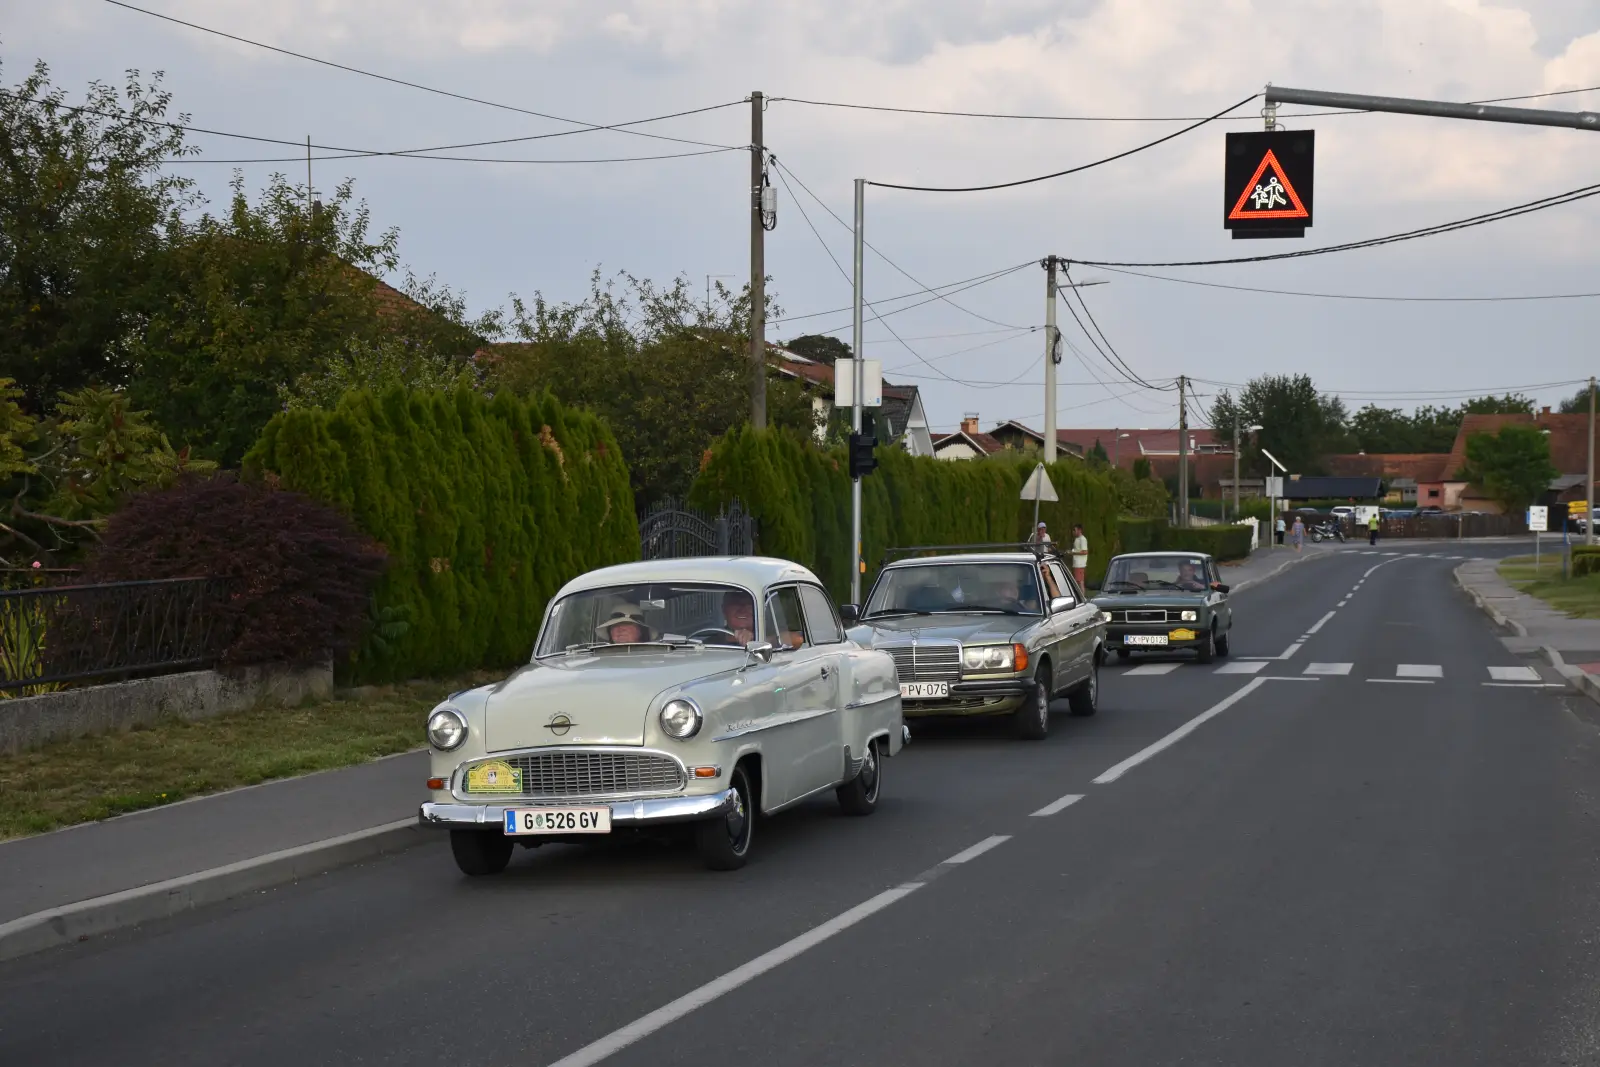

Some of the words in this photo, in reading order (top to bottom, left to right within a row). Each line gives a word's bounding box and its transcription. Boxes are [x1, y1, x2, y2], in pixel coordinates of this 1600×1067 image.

[908, 683, 948, 696] PV-076
[524, 813, 534, 830] G
[545, 812, 576, 830] 526
[579, 811, 599, 829] GV
